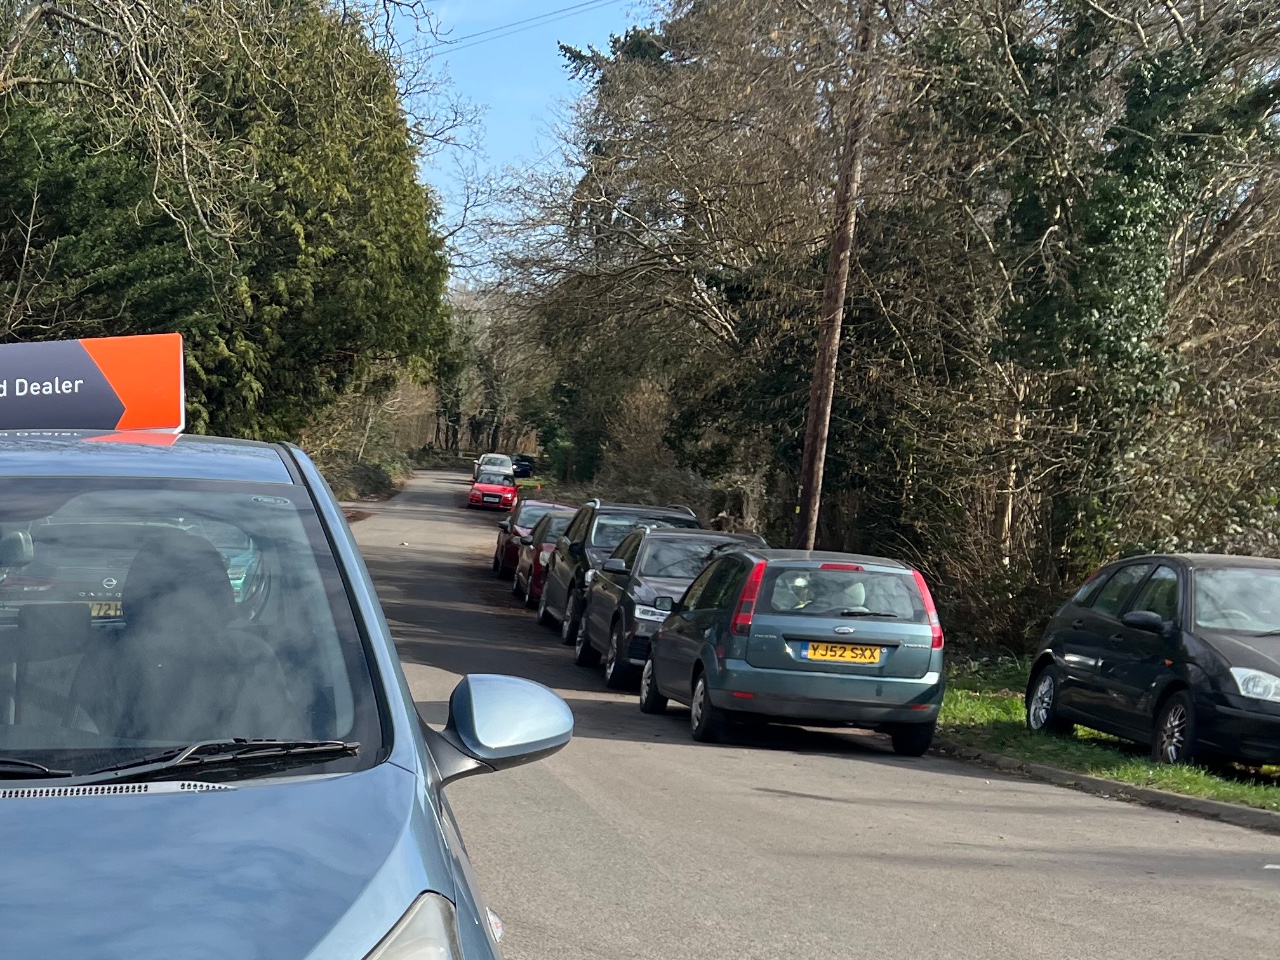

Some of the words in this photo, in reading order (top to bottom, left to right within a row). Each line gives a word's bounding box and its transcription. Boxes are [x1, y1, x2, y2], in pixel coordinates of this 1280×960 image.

[15, 377, 84, 396] Dealer
[811, 644, 847, 658] YJ52
[850, 646, 878, 660] SXX
